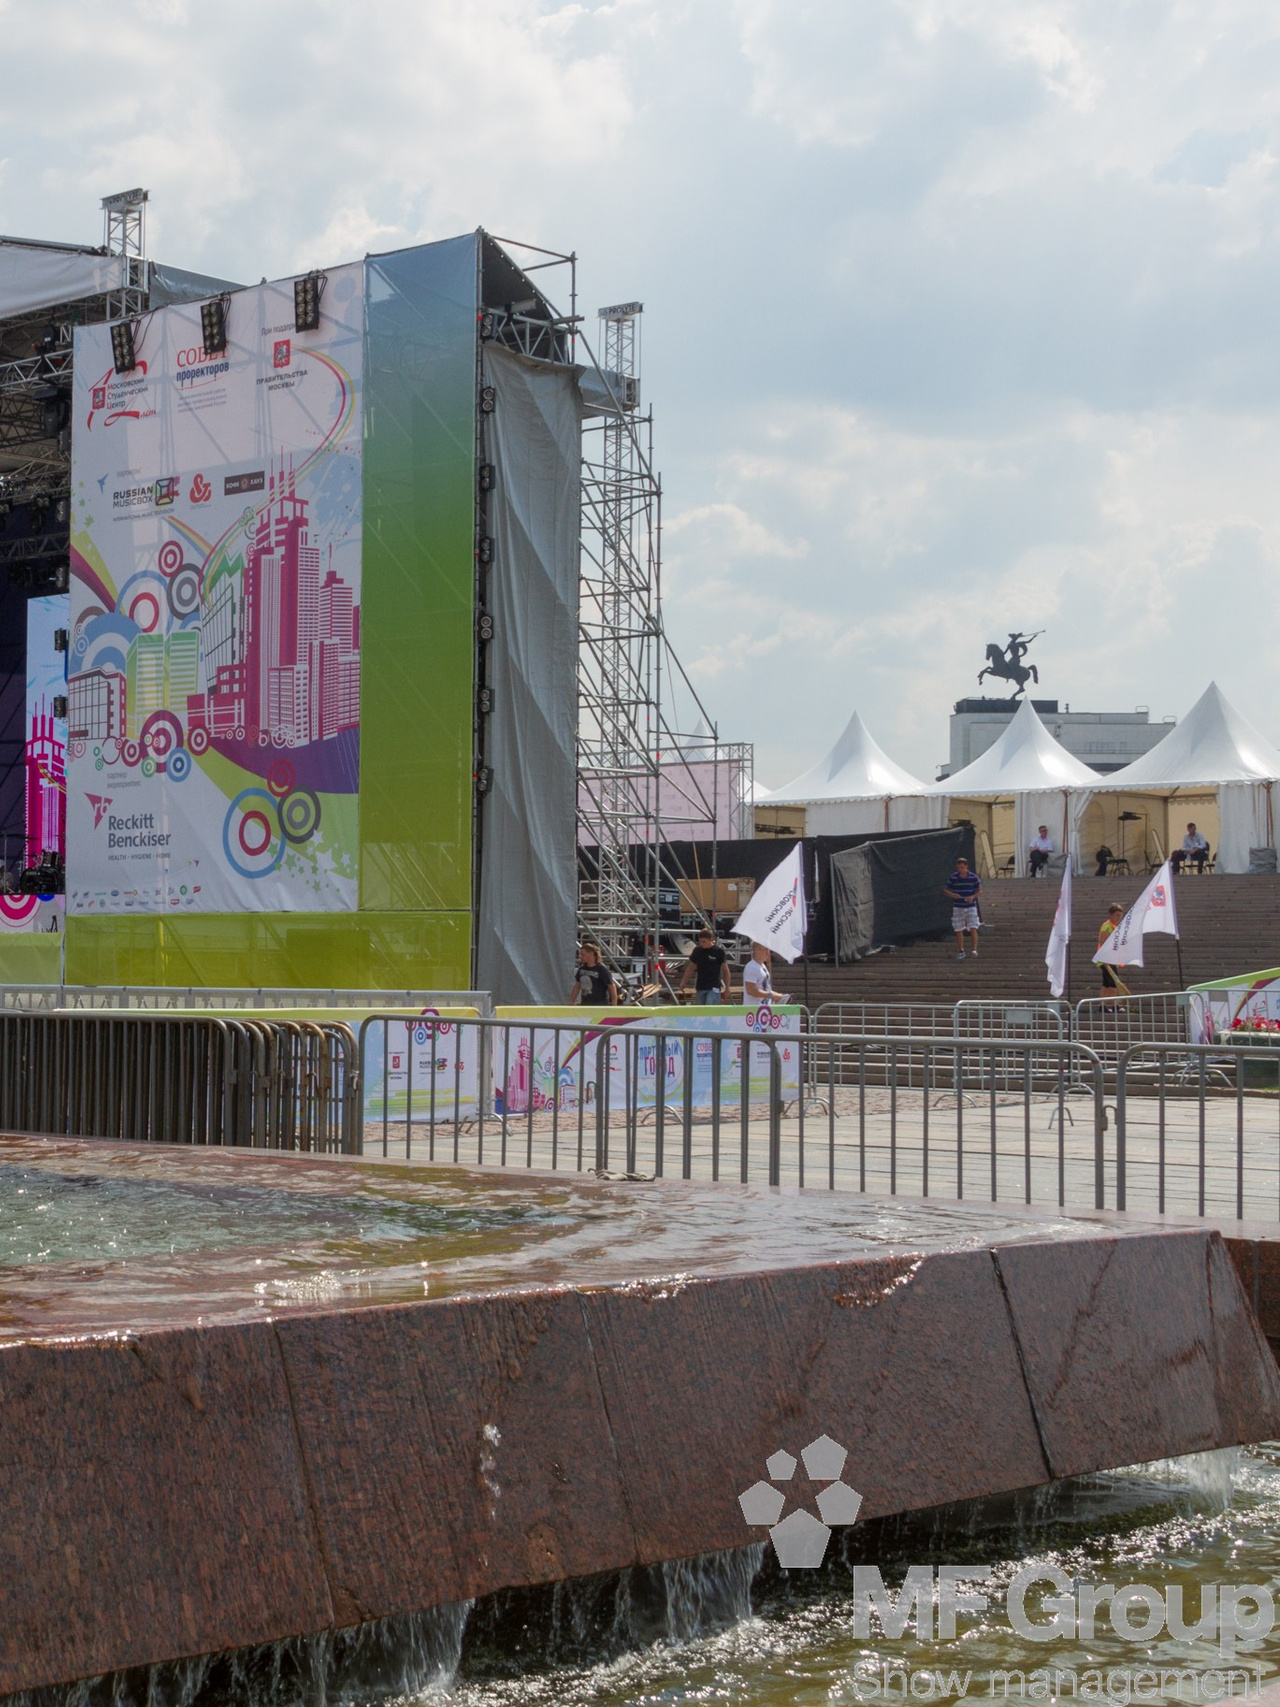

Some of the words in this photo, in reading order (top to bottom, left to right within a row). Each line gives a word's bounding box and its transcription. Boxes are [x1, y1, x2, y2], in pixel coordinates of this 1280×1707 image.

[176, 362, 230, 387] проректоров
[256, 369, 308, 385] ПРАВИТЕЛЬСТВА
[113, 485, 154, 500] RUSSIAN
[112, 495, 153, 509] MUSICBOX
[108, 813, 154, 831] Reckitt
[108, 831, 171, 848] Benckiser
[644, 1056, 676, 1078] ГОД
